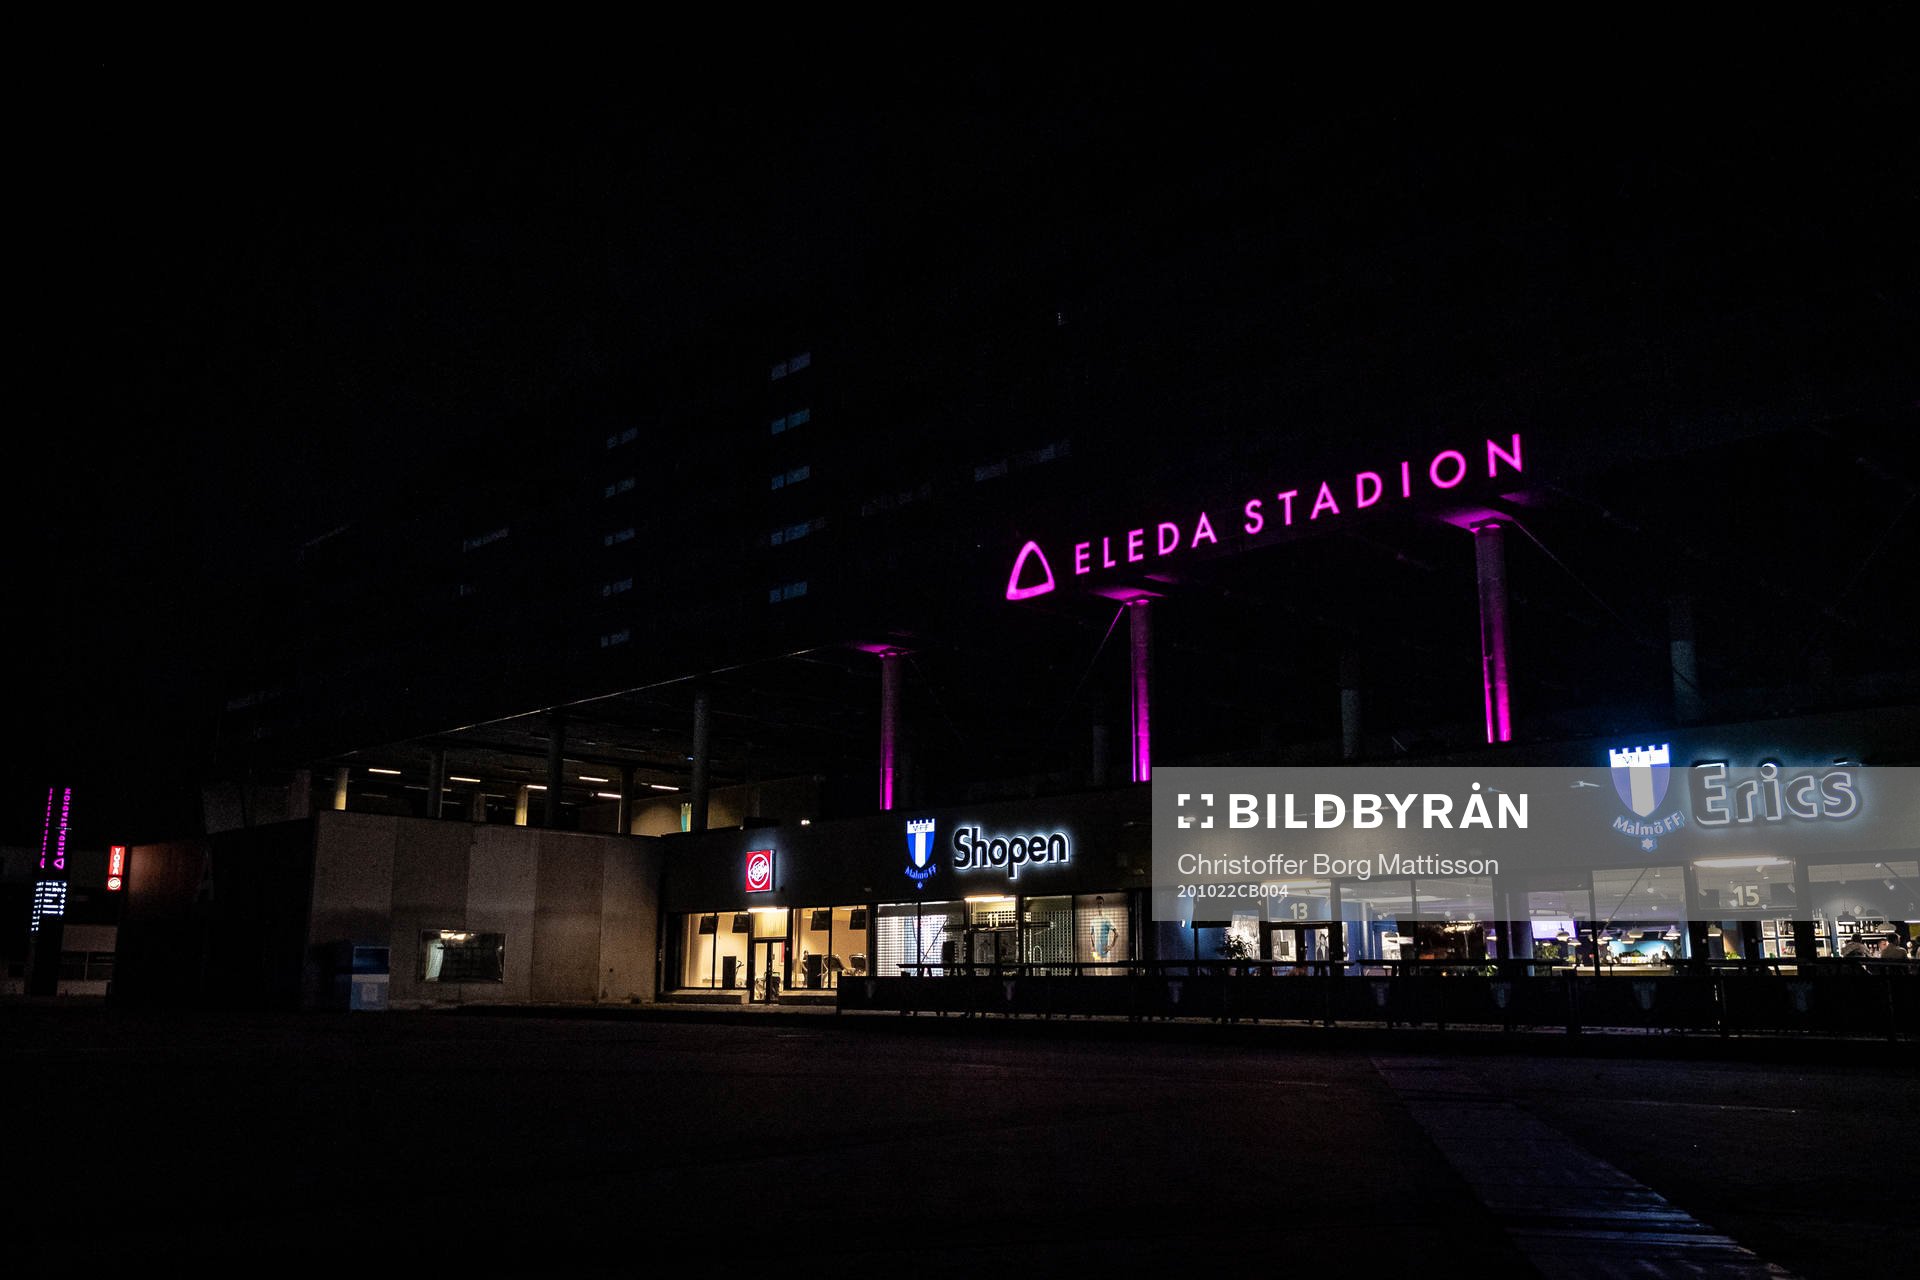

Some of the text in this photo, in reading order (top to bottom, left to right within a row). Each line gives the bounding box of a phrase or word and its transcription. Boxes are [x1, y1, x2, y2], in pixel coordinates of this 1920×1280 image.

[1075, 433, 1523, 575] ELEDA STADION
[1690, 760, 1860, 826] Erics
[1612, 811, 1682, 836] Malmö FF
[56, 829, 67, 857] ELEDA
[954, 826, 1070, 880] Shopen
[1732, 885, 1760, 907] 15
[987, 913, 999, 927] 11
[1290, 902, 1308, 920] 13
